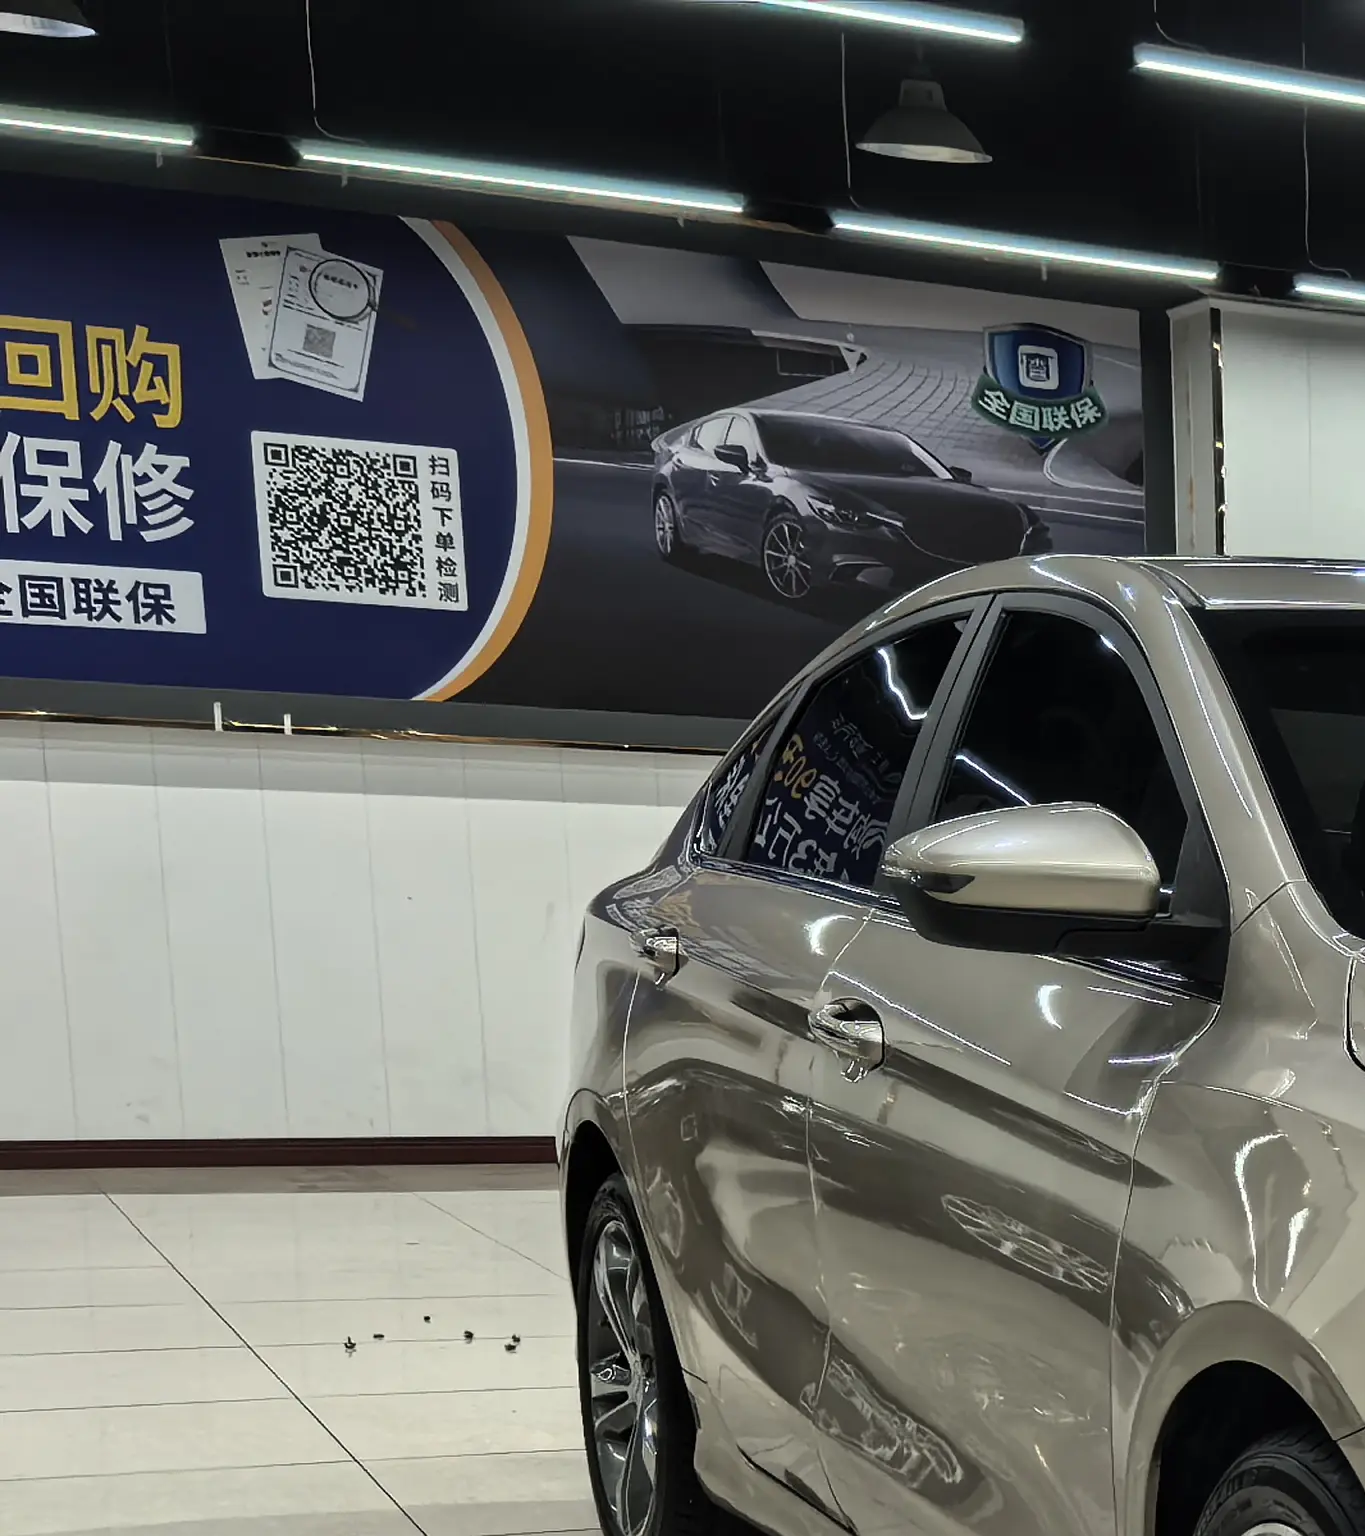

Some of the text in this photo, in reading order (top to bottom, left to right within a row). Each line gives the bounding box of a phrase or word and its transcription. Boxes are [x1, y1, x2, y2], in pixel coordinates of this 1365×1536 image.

[0, 315, 183, 429] 回购
[978, 389, 1102, 432] 全国联保
[0, 431, 195, 543] 保修
[428, 454, 460, 604] 扫码下单检测
[0, 574, 177, 626] 国联保
